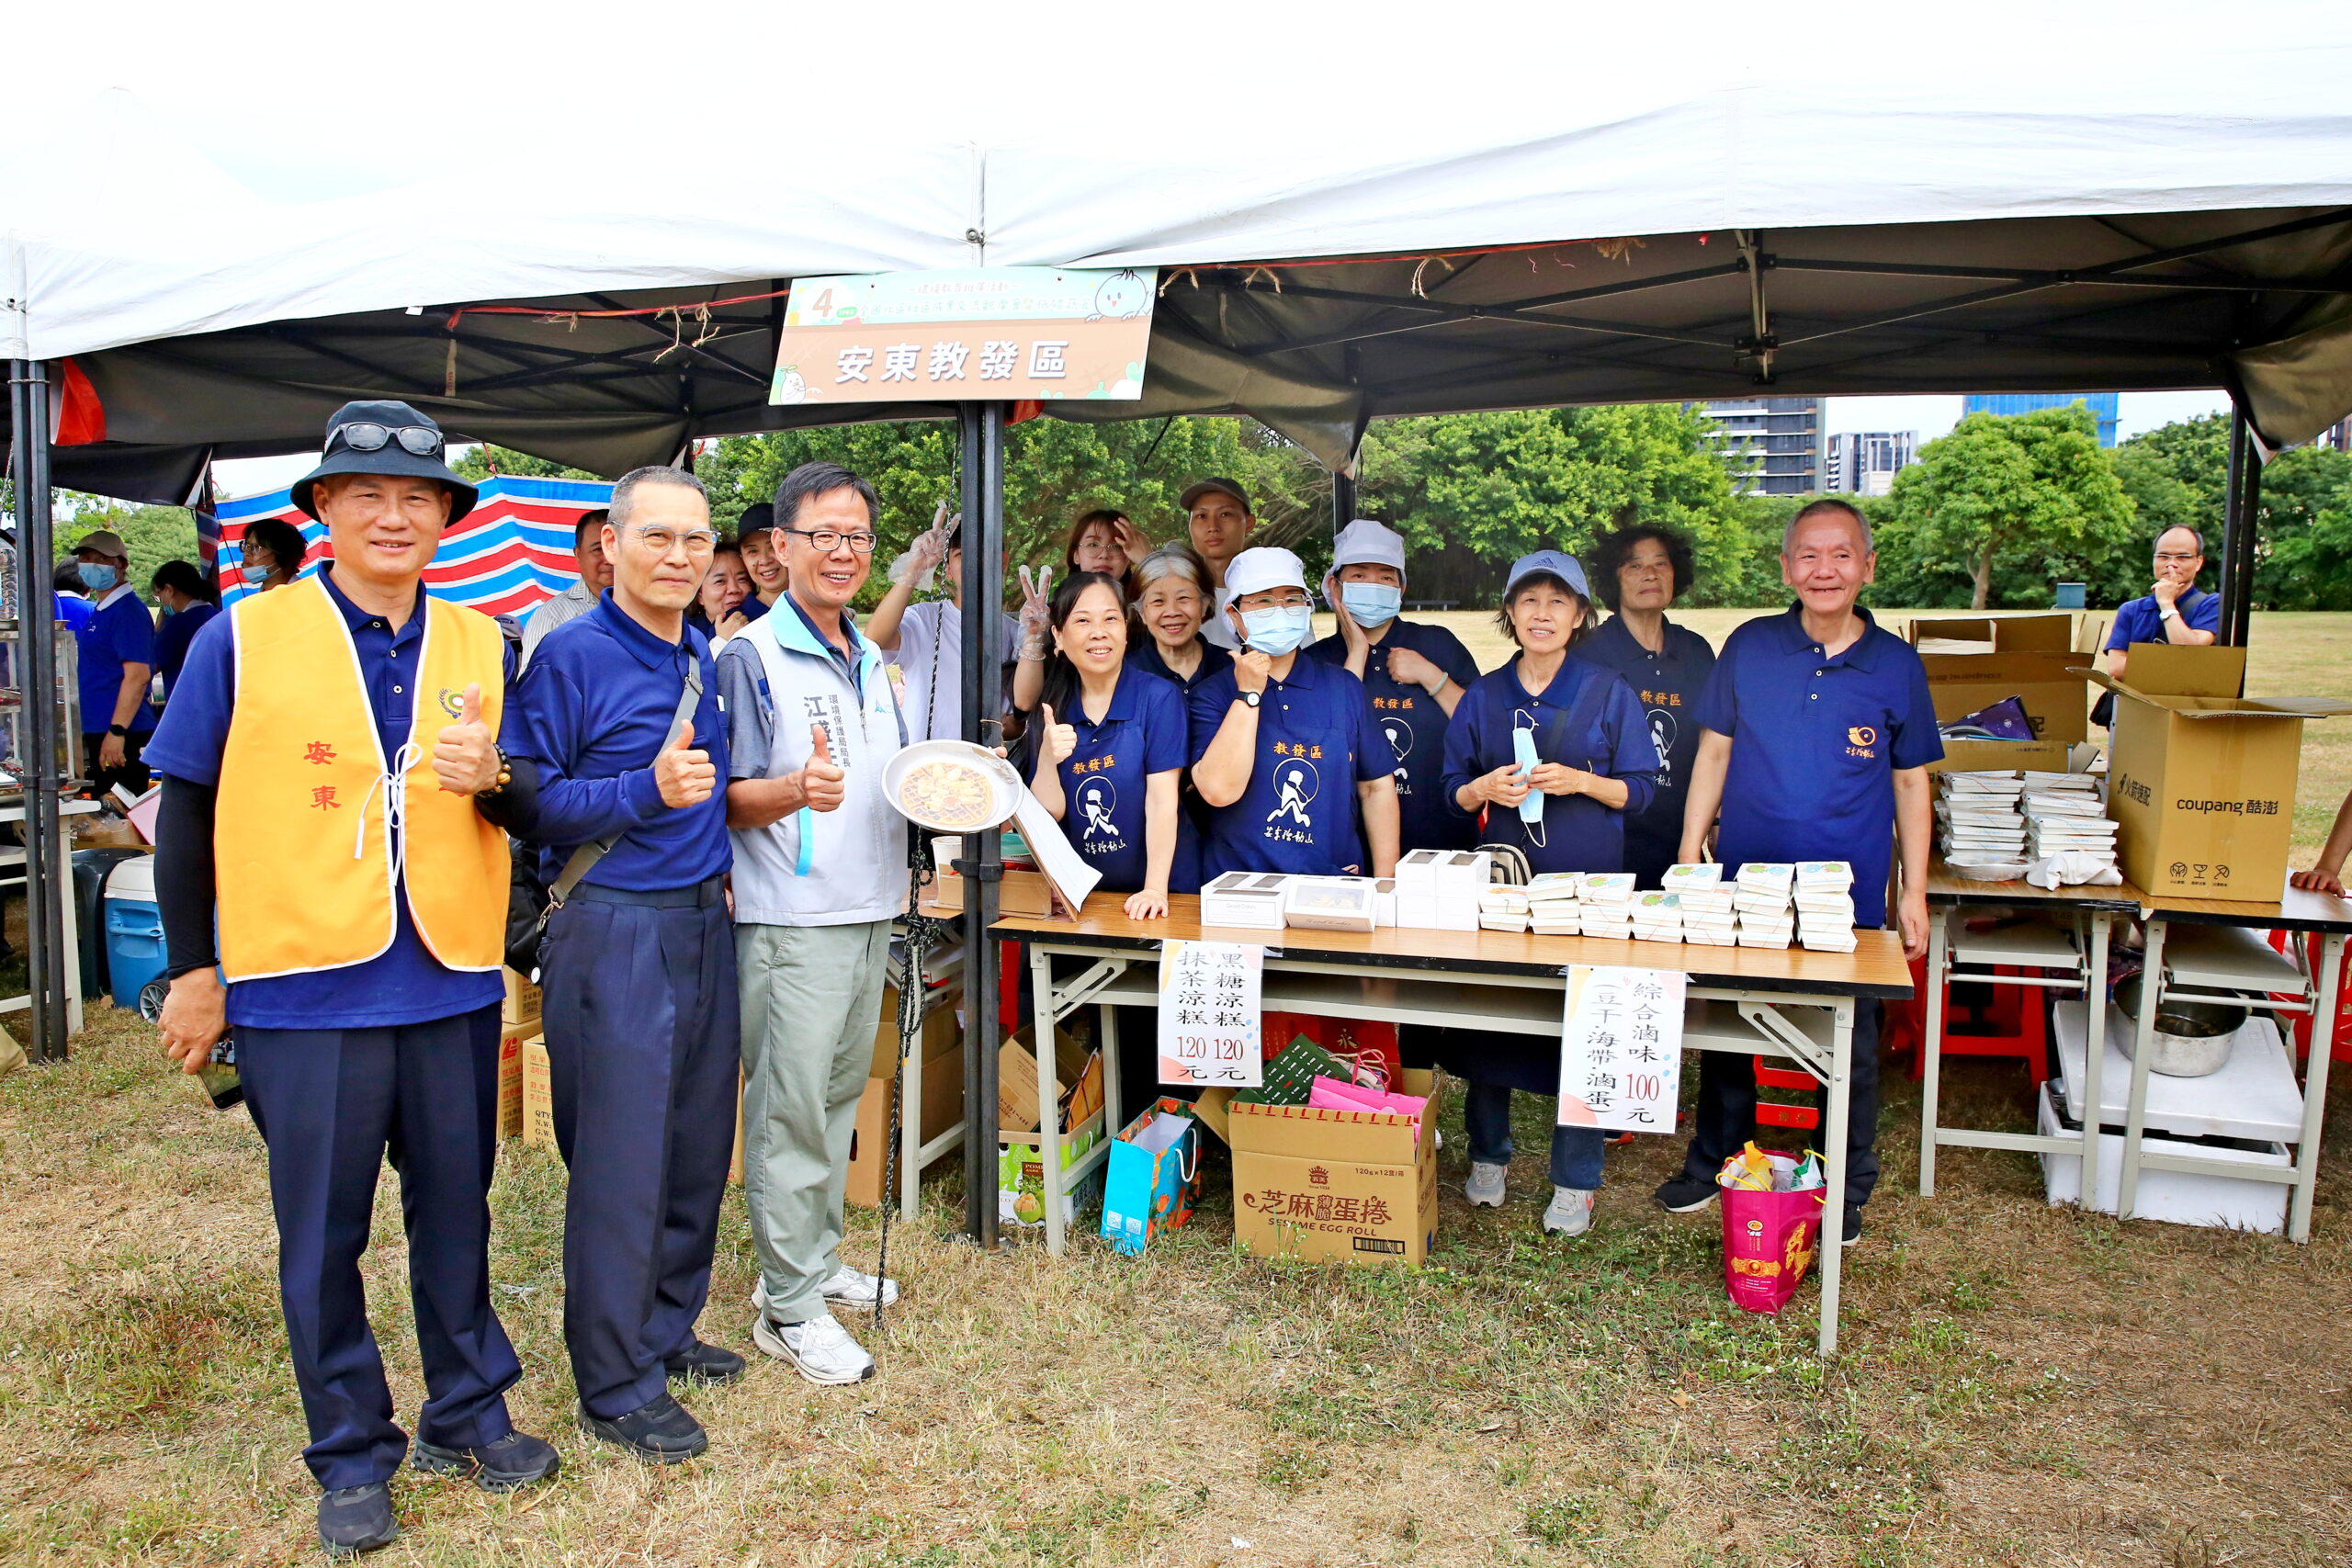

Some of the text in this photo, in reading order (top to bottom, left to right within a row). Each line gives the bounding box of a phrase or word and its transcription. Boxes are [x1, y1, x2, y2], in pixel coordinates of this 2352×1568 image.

[811, 288, 833, 318] 4
[834, 340, 1069, 384] 安東教發區
[1373, 697, 1414, 709] 教發區
[1640, 690, 1682, 706] 教發區
[828, 694, 852, 768] 環境保護局局長
[1273, 740, 1323, 759] 教發區
[304, 740, 342, 811] 安東
[1073, 754, 1115, 775] 教發區
[2177, 799, 2278, 817] coupang 酷澎
[1176, 951, 1211, 1079] 抹茶涼糕 120 元
[1214, 953, 1247, 1080] 黑糖涼糕 120 元
[1337, 1028, 1361, 1049] 永
[1625, 983, 1663, 1123] 綜合滷味 100 元
[1268, 1217, 1377, 1236] SESAME EGG ROLL
